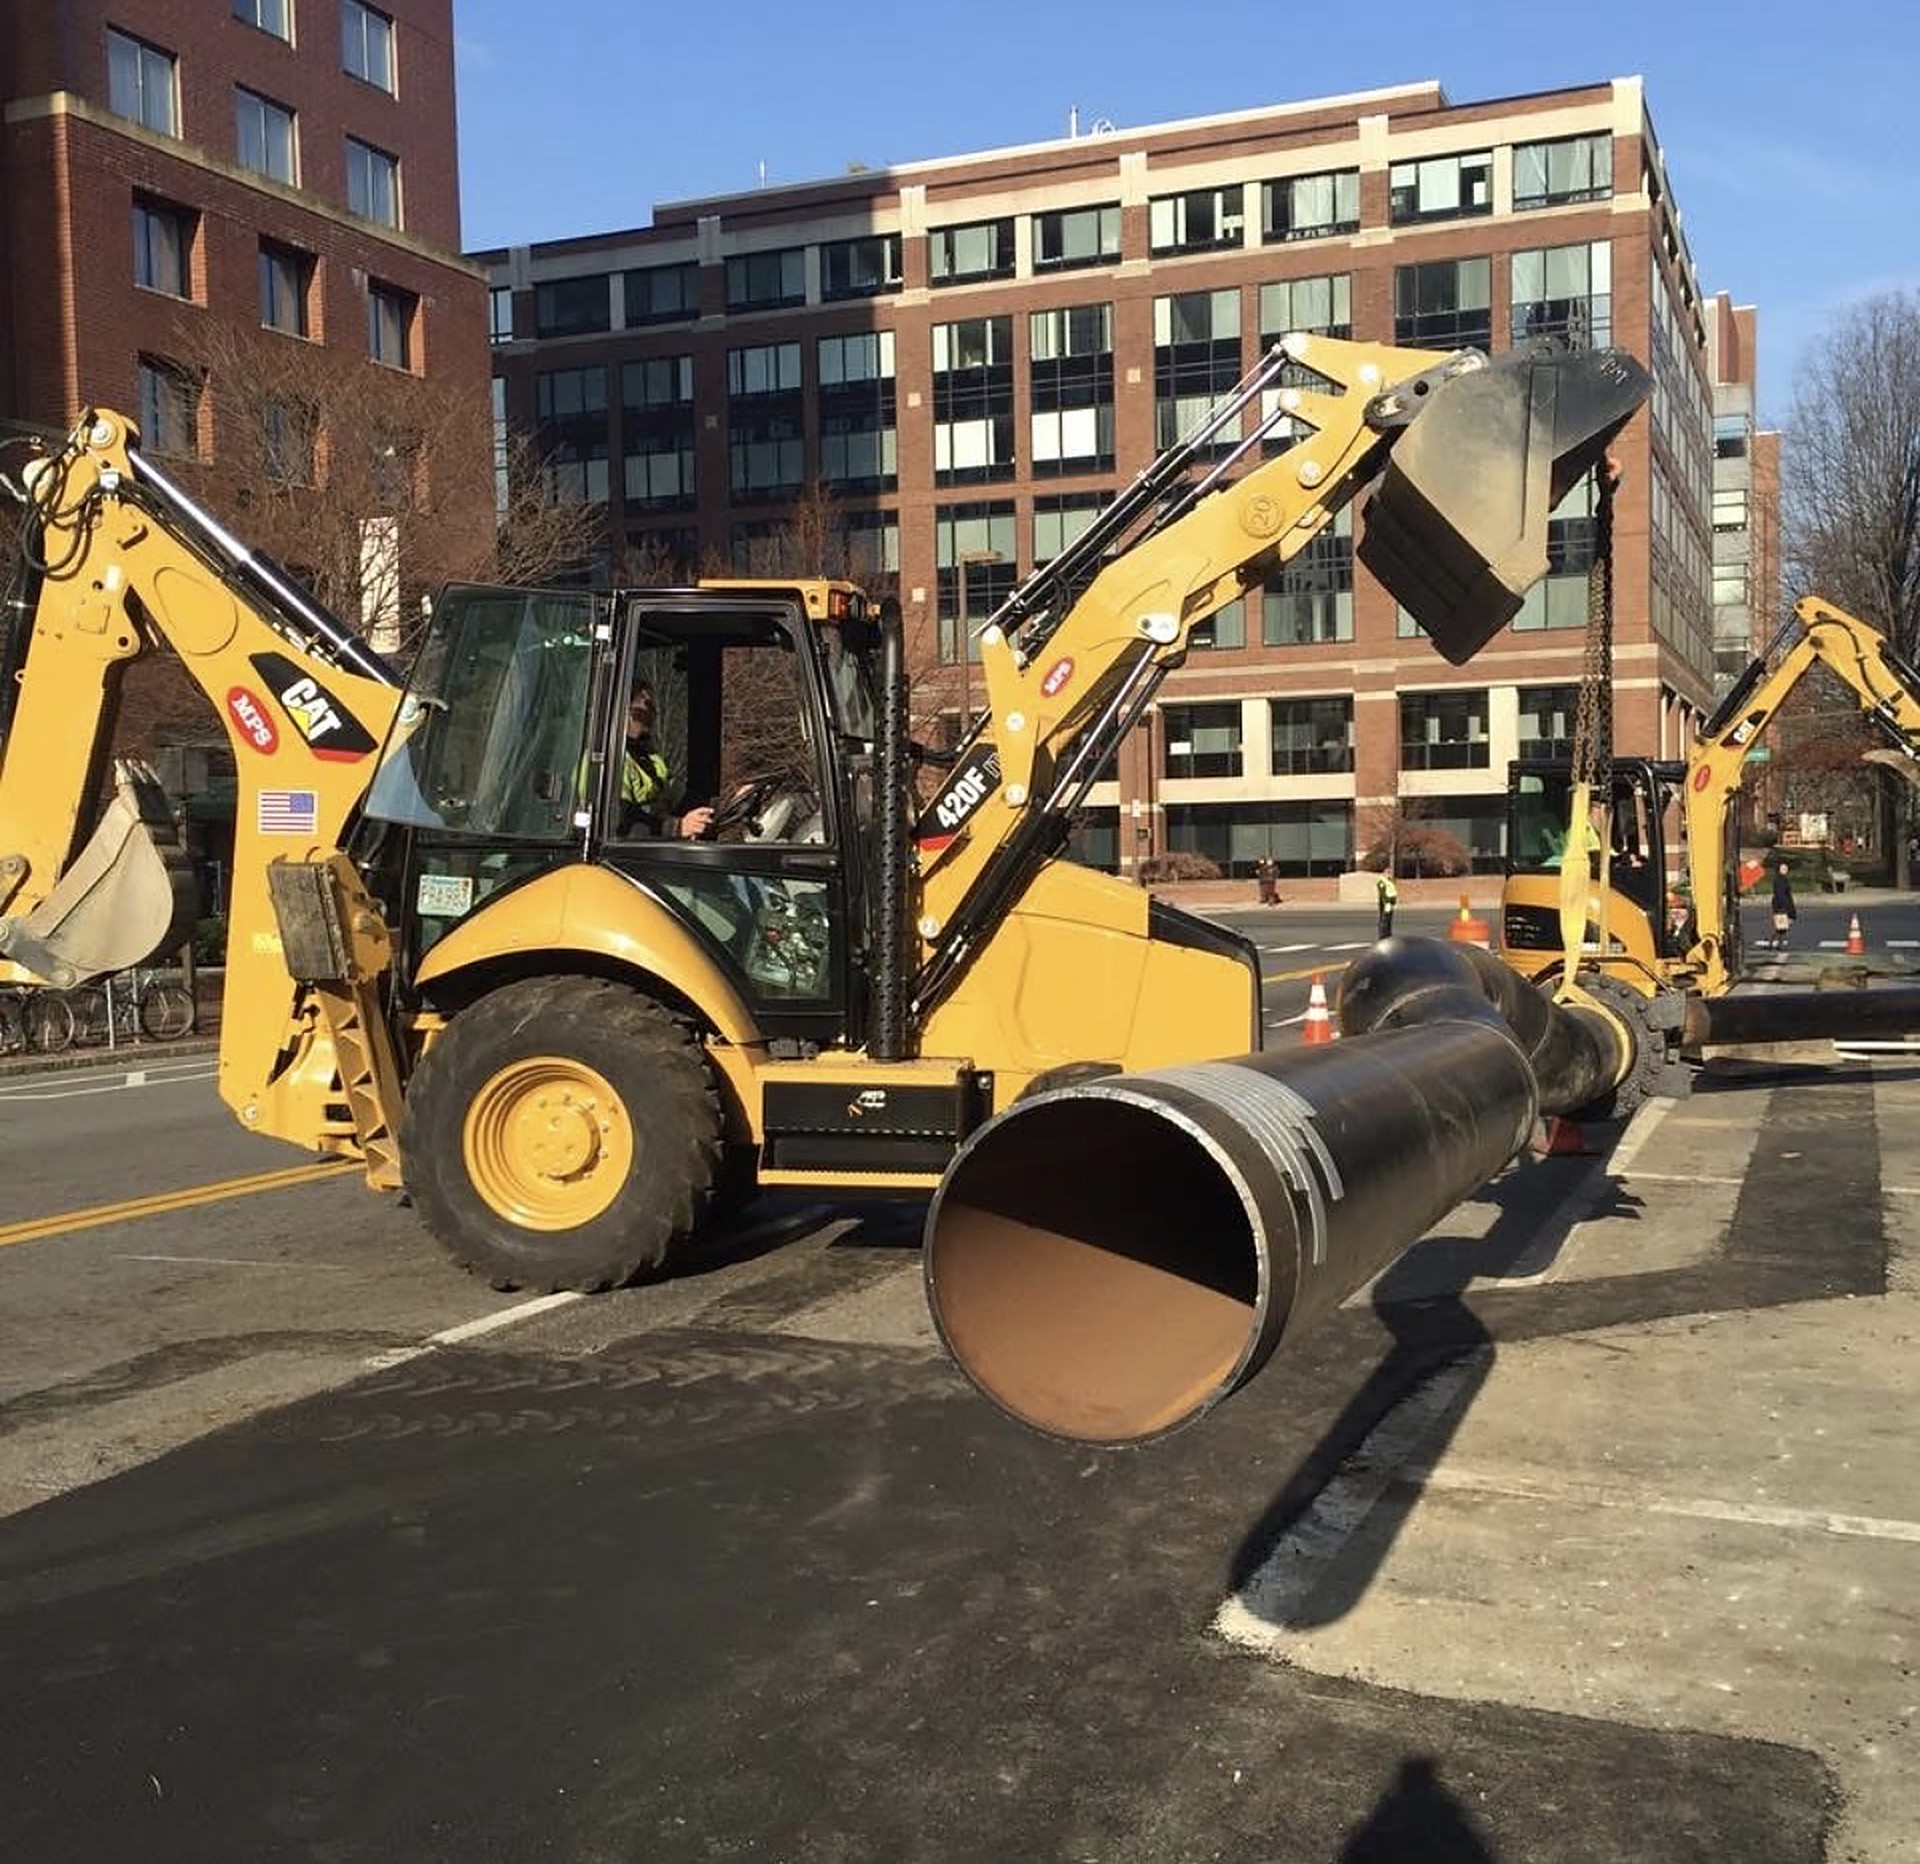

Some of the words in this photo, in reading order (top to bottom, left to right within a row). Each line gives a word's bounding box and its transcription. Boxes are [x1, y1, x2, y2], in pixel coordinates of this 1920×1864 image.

[1044, 660, 1072, 695] MPS
[231, 693, 273, 747] MPS
[281, 677, 342, 742] CAT
[1733, 719, 1756, 744] CAT
[936, 766, 987, 829] 420F
